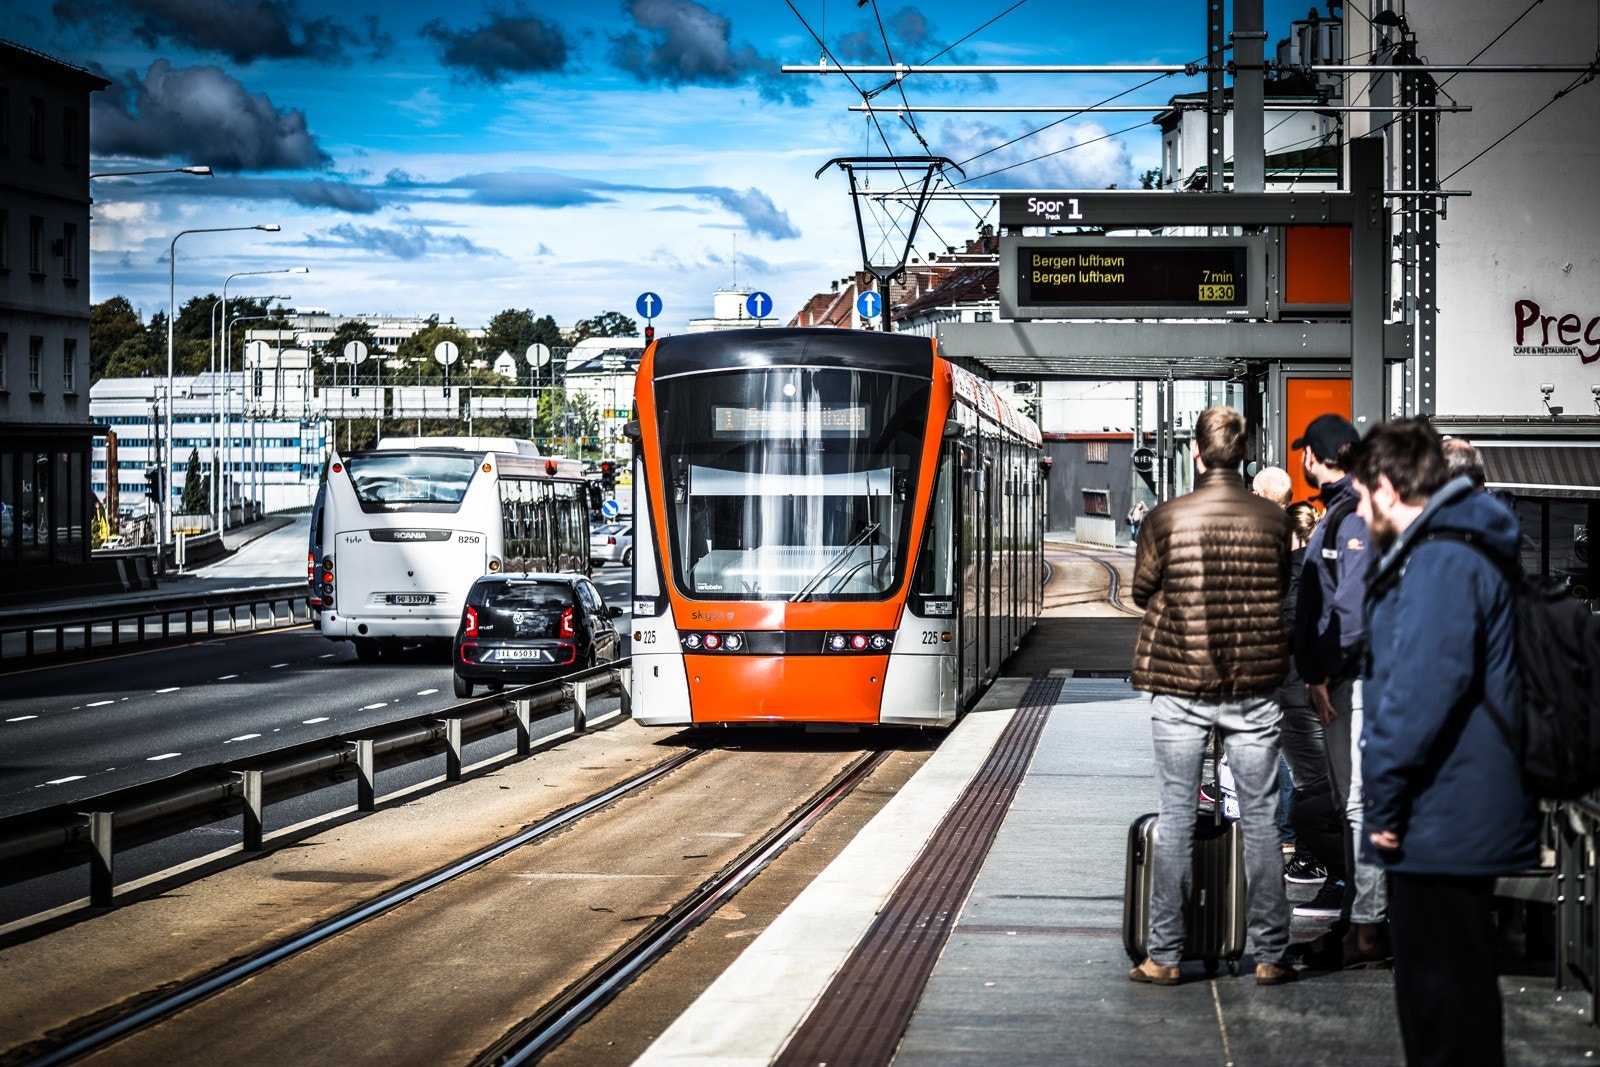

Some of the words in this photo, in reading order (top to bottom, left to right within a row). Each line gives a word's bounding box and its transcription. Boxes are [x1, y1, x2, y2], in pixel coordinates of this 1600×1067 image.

[1028, 197, 1065, 216] Spor
[1068, 198, 1083, 219] 1
[1032, 254, 1076, 269] Bergen
[1079, 254, 1125, 267] lufthavn
[1032, 270, 1076, 285] Bergen
[1079, 270, 1125, 283] lufthavn
[1202, 270, 1209, 283] 7
[1211, 271, 1233, 283] min
[1199, 286, 1234, 300] 13:30
[1537, 346, 1577, 354] RESTAURANT
[643, 630, 656, 644] 225
[922, 630, 938, 645] 225
[513, 650, 538, 658] 65033
